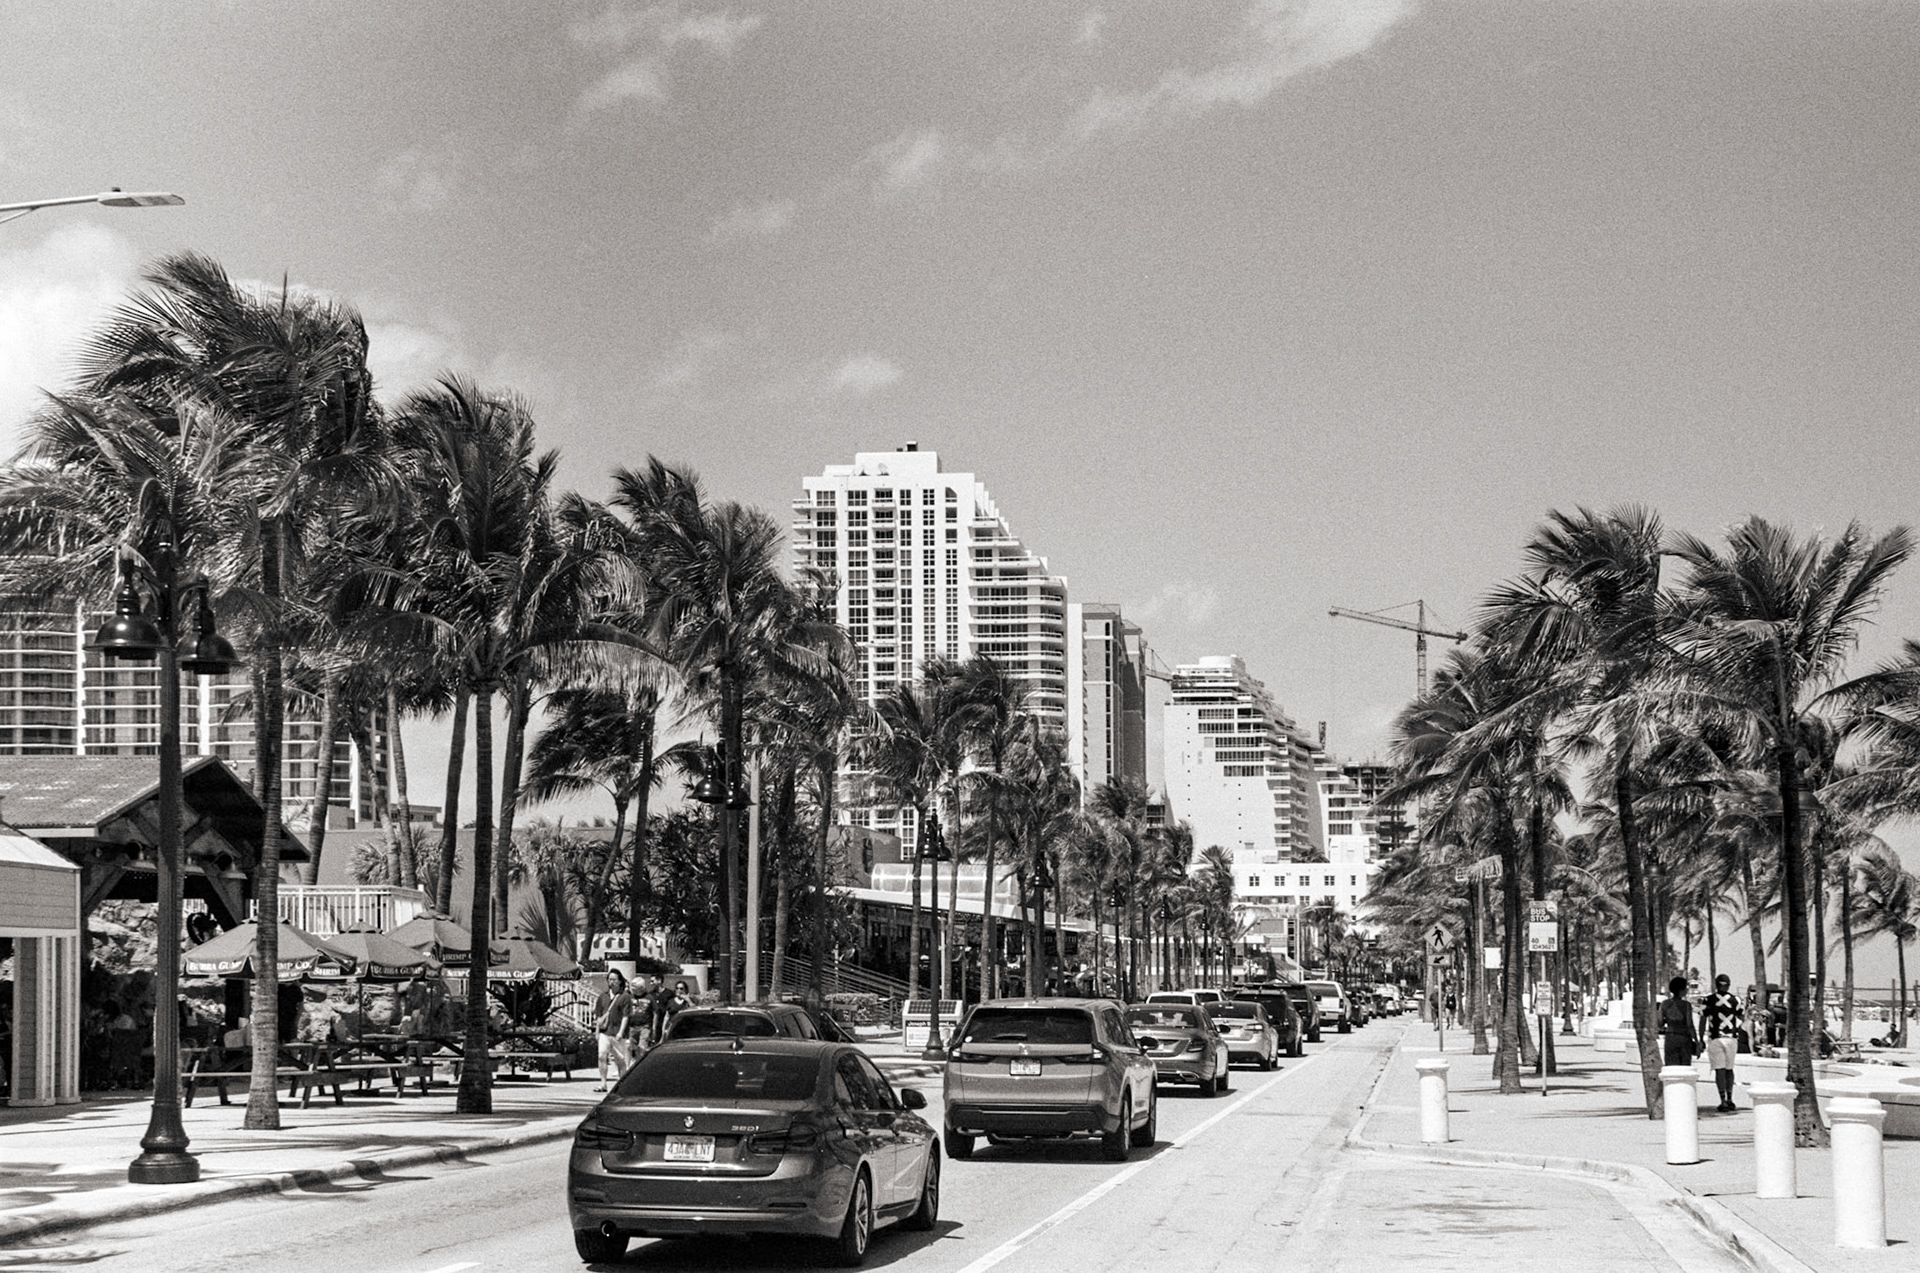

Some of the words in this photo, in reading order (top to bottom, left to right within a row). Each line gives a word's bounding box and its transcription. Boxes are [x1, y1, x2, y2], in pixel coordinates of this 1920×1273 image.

[313, 966, 340, 976] SHRIM
[373, 965, 399, 975] BUBBA
[400, 966, 423, 975] GUMP
[487, 970, 511, 978] BUBBA
[513, 970, 535, 978] GUMP
